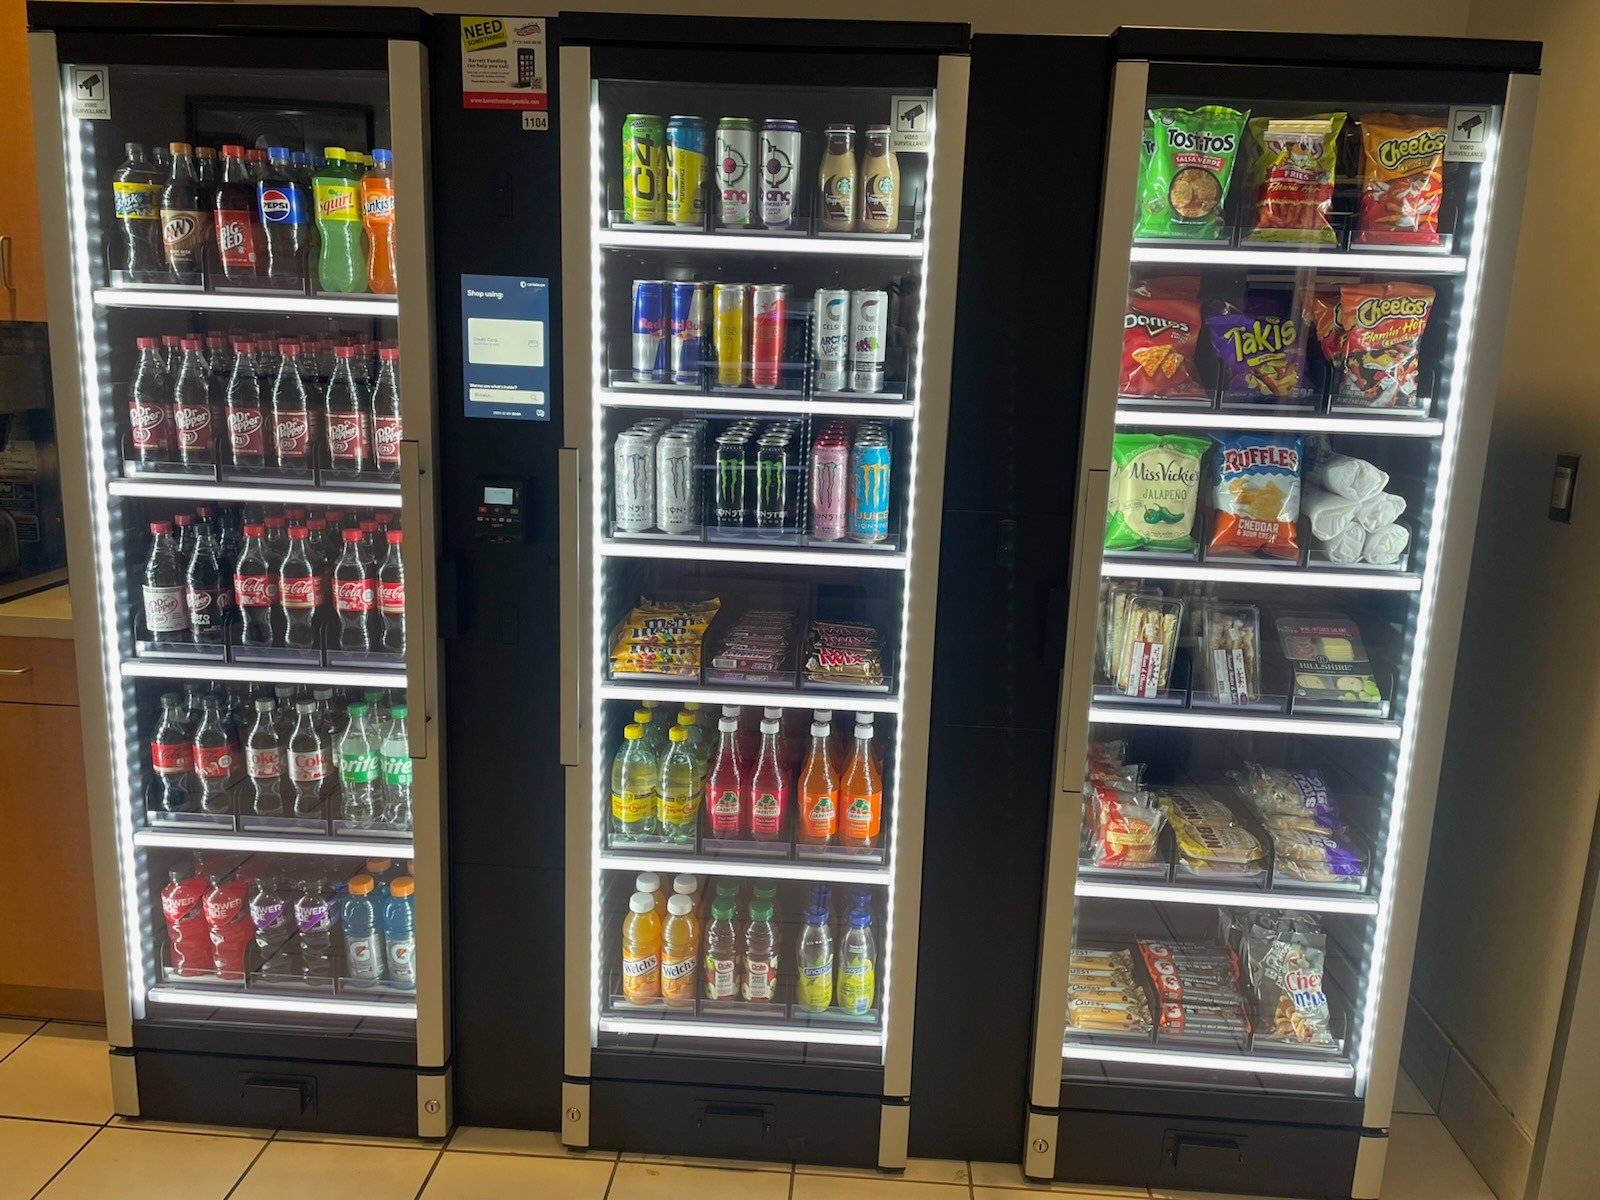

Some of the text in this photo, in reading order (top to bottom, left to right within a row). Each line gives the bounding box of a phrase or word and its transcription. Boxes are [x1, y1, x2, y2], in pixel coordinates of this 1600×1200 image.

[464, 20, 502, 39] NEED
[524, 118, 546, 127] 1104
[1379, 133, 1446, 168] Cheetos
[634, 134, 655, 200] C4
[1198, 157, 1222, 167] VERDE
[1284, 171, 1309, 181] FRIES
[263, 200, 289, 210] PEPSI
[221, 222, 238, 238] BIG
[222, 232, 243, 250] RED
[467, 289, 504, 300] Shop using:
[1357, 298, 1425, 327] Cheetos
[1224, 320, 1297, 362] Takis
[1223, 446, 1298, 473] RUFFLES
[1131, 462, 1163, 480] Miss
[1143, 488, 1187, 500] JALAPEÑO
[1238, 519, 1279, 533] CHEDDAR
[1299, 662, 1352, 672] HILLSHIRE
[1196, 826, 1223, 848] BUN
[624, 956, 656, 975] Welch's
[663, 959, 696, 977] Welch's
